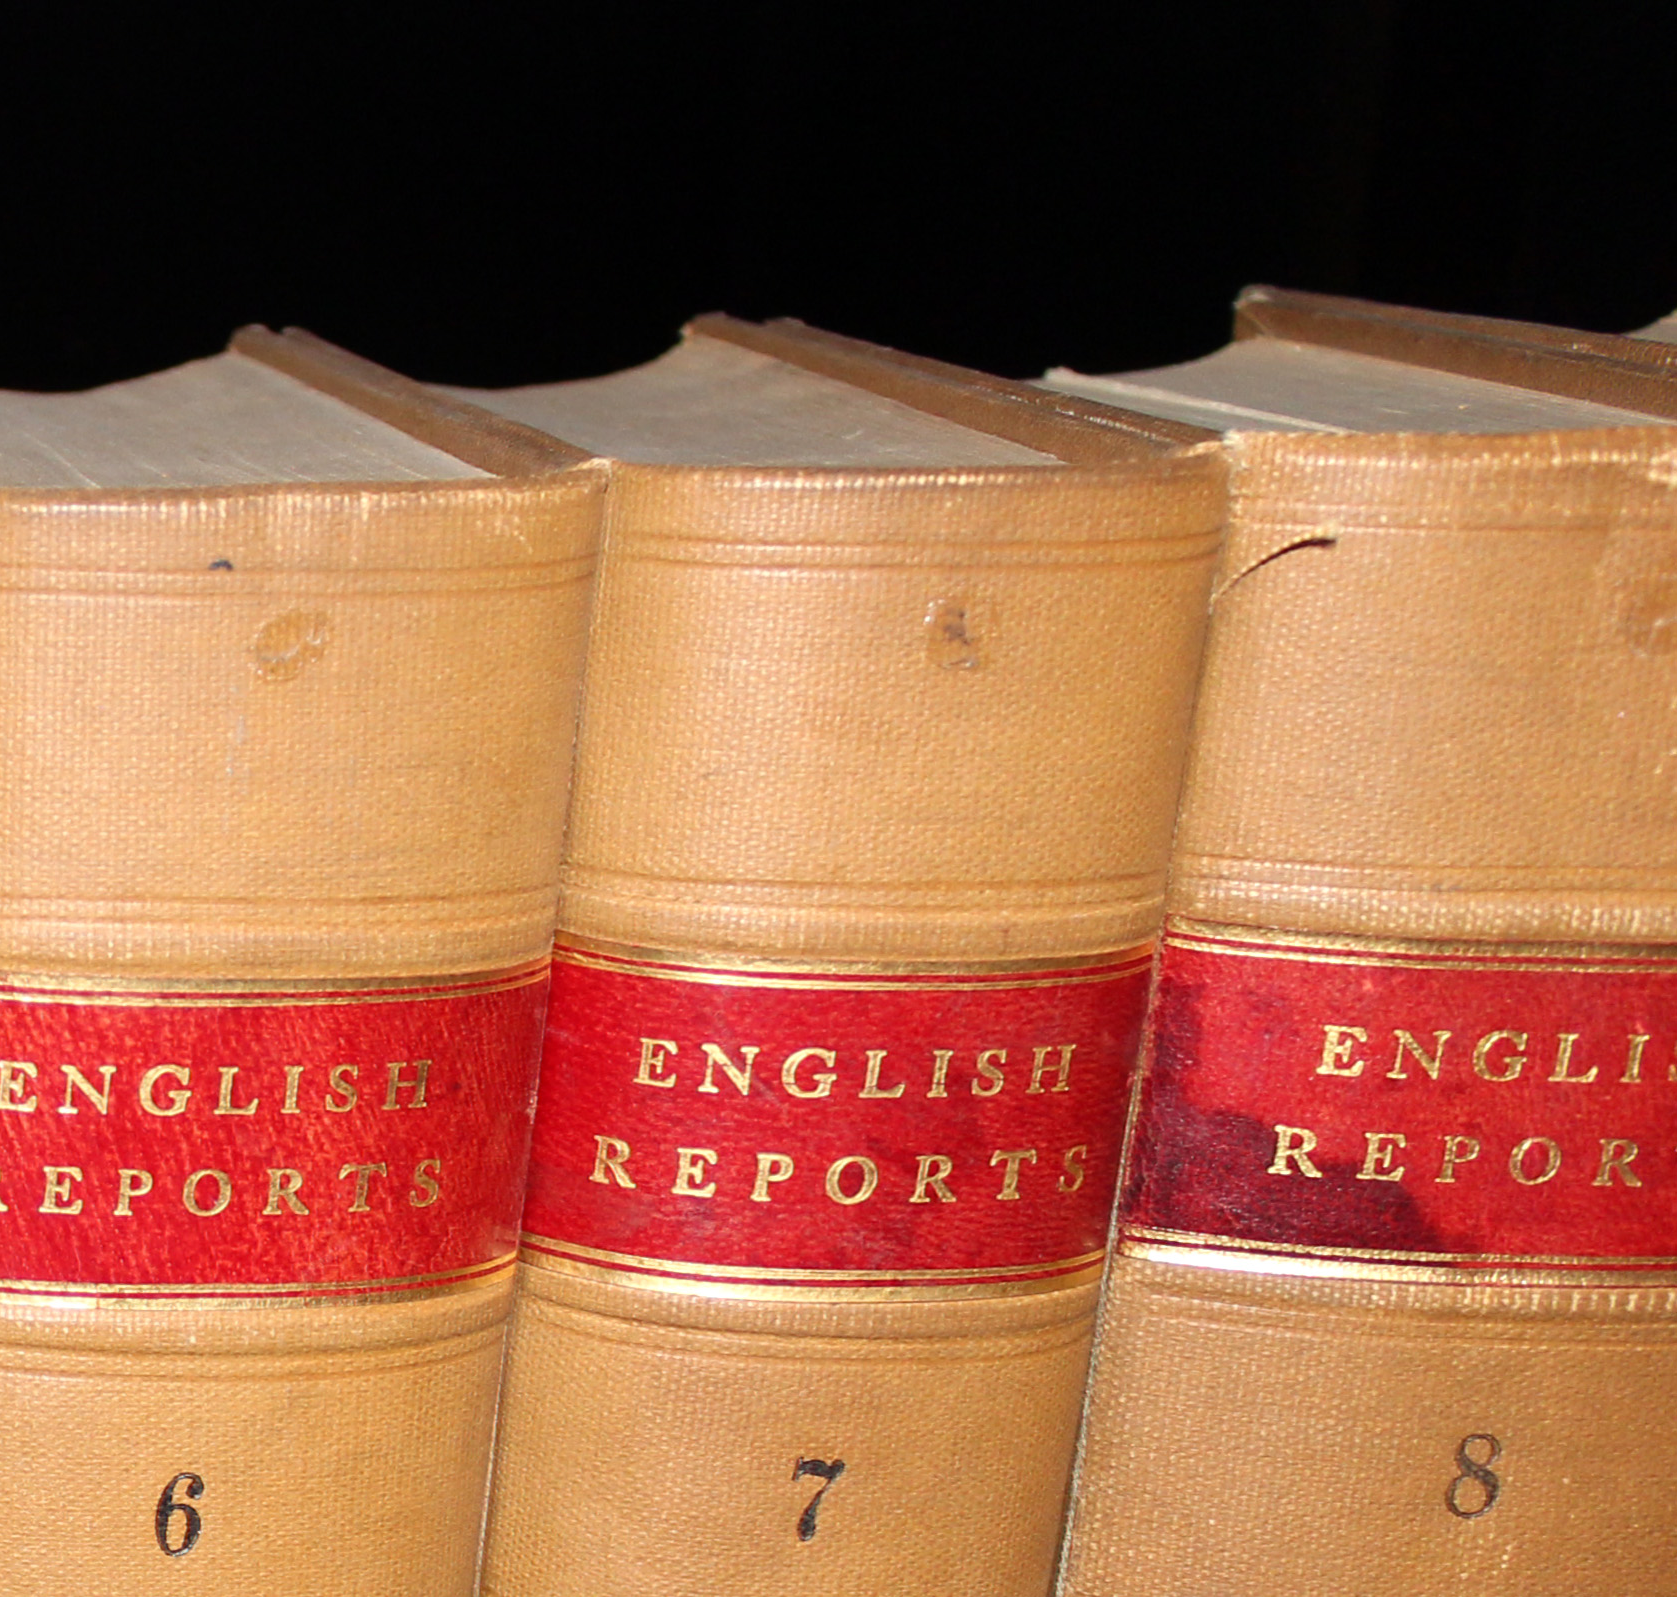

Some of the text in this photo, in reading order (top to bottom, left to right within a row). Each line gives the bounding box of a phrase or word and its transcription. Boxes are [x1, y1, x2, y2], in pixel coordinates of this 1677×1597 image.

[633, 1036, 1078, 1102] ENGLISH
[1316, 1024, 1677, 1085] ENGLI
[587, 1133, 1089, 1206] REPORTS
[1267, 1122, 1677, 1188] REPOR
[791, 1456, 846, 1542] 7
[1447, 1433, 1502, 1519] 8
[154, 1472, 205, 1558] 6
